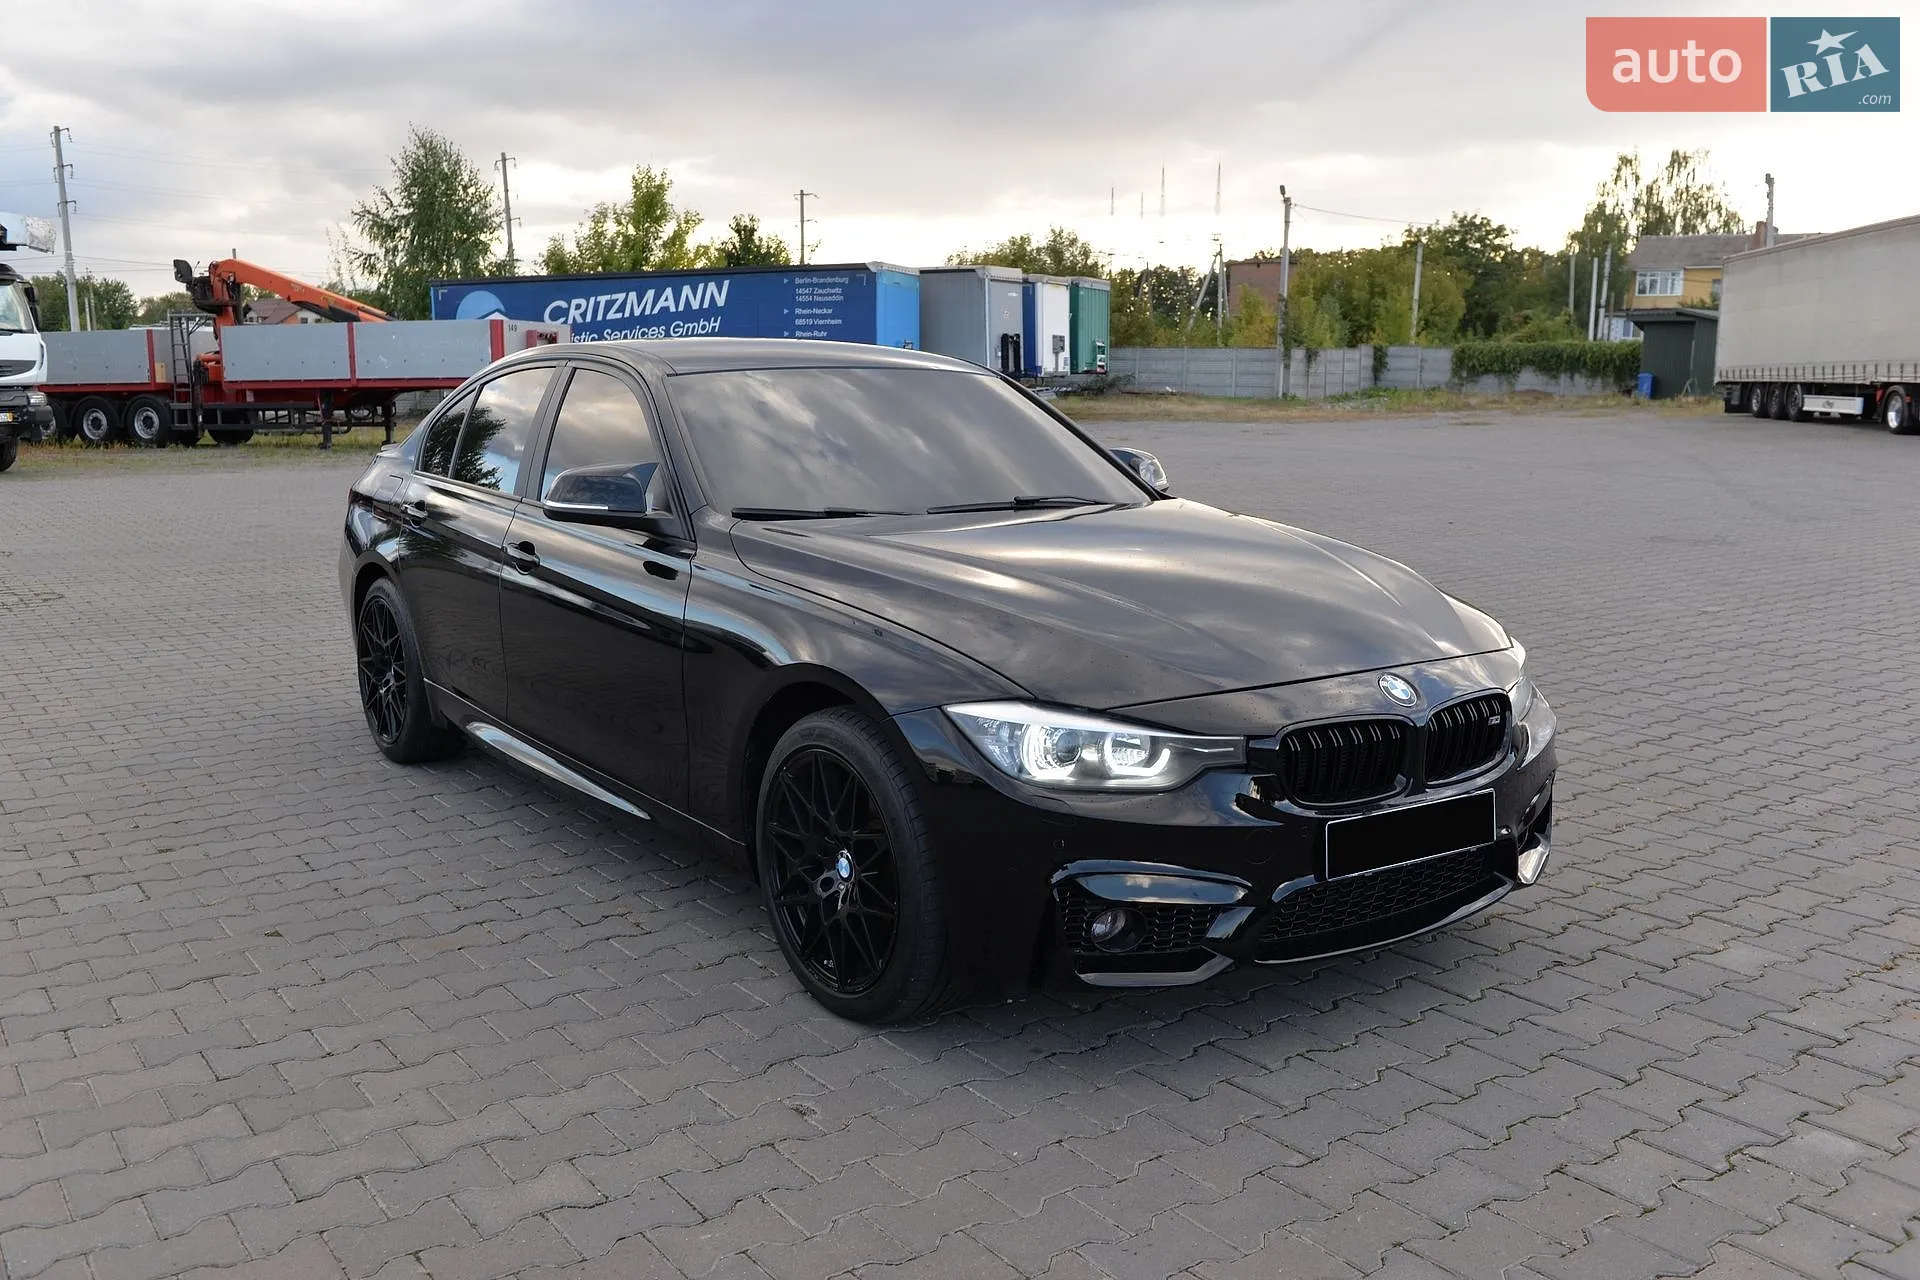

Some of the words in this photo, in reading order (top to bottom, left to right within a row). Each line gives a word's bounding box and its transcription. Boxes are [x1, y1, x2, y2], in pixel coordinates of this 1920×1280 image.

[794, 276, 849, 284] Berlin-Brandenburg
[543, 280, 729, 325] CRITZMANN
[571, 331, 598, 343] istic
[604, 324, 666, 341] Services
[670, 316, 721, 337] GmbH
